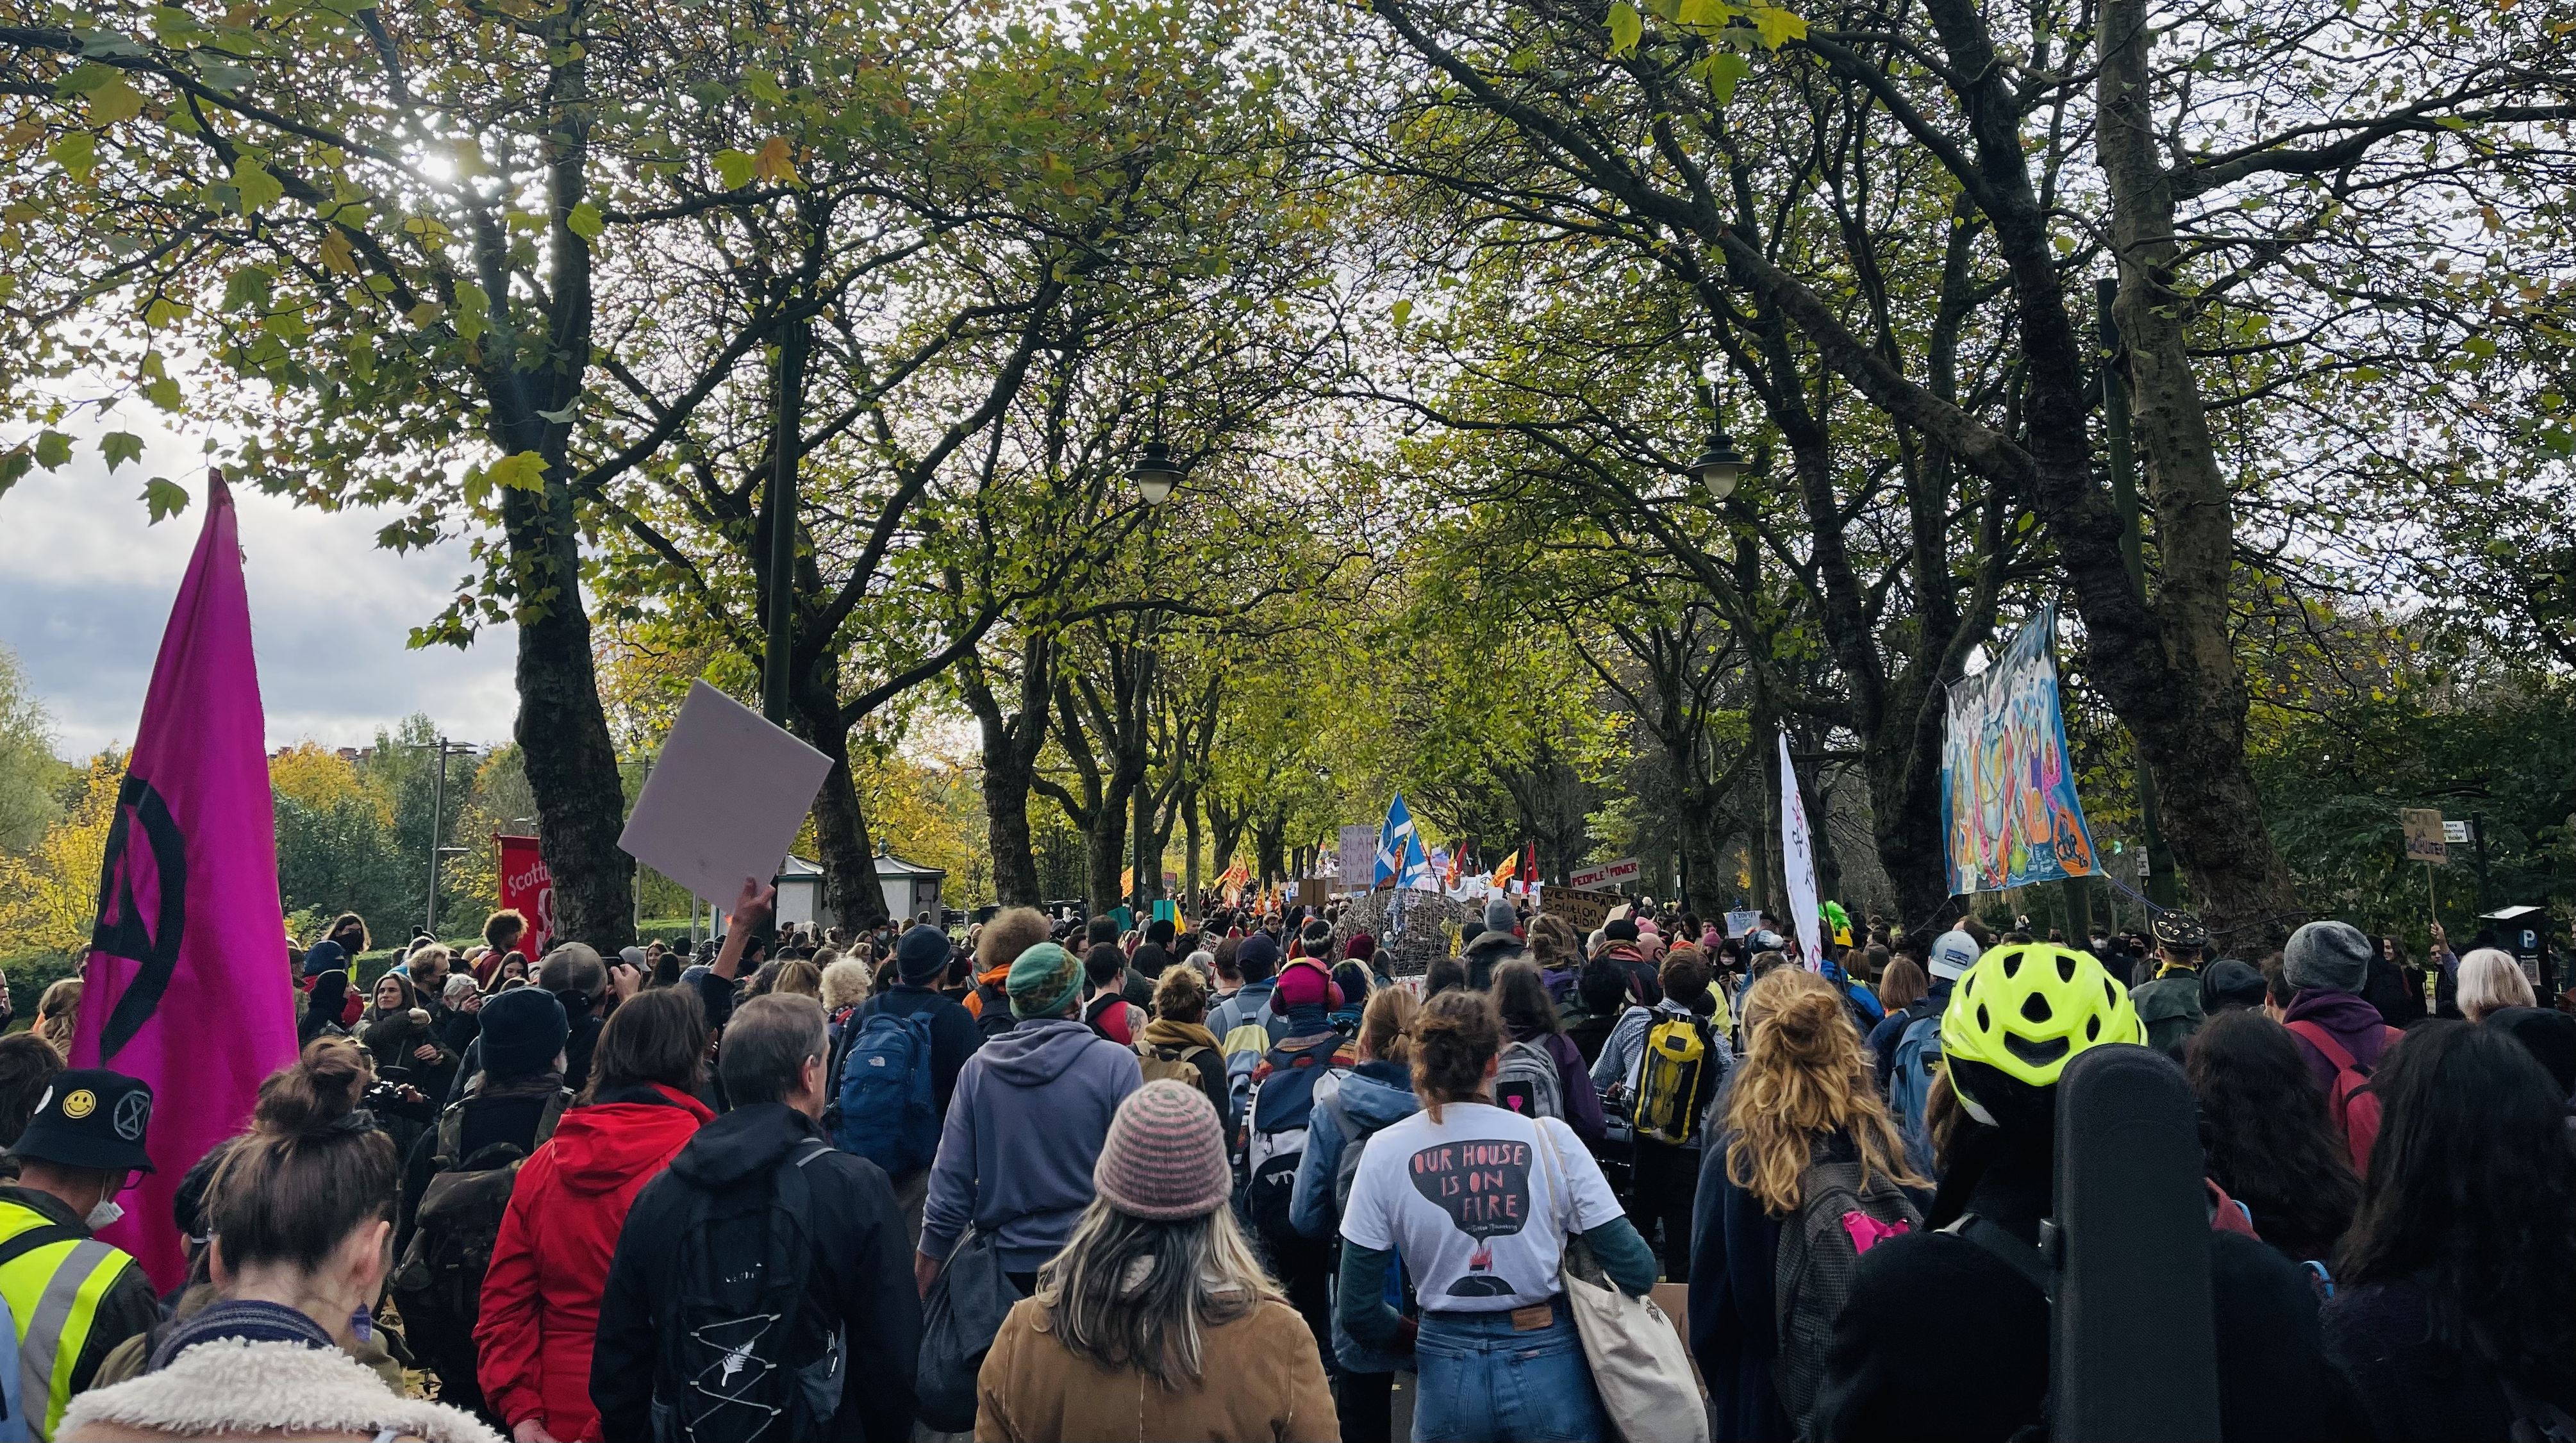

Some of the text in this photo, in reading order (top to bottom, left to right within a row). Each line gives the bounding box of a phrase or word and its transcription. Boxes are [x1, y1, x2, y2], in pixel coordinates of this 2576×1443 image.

[1342, 837, 1374, 851] BLAH
[1342, 852, 1374, 866] BLAH
[1342, 867, 1374, 883] BLAH
[1572, 871, 1605, 887] PEOPLE
[1609, 862, 1637, 877] POWER
[1541, 889, 1606, 907] WE NEED A
[1543, 898, 1597, 917] Solution
[1205, 932, 1217, 941] END
[2523, 930, 2535, 947] P
[1200, 944, 1215, 954] FUEL
[1414, 1144, 1525, 1174] OUR HOUSE
[1441, 1169, 1503, 1197] IS ON
[1462, 1194, 1518, 1221] FIRE
